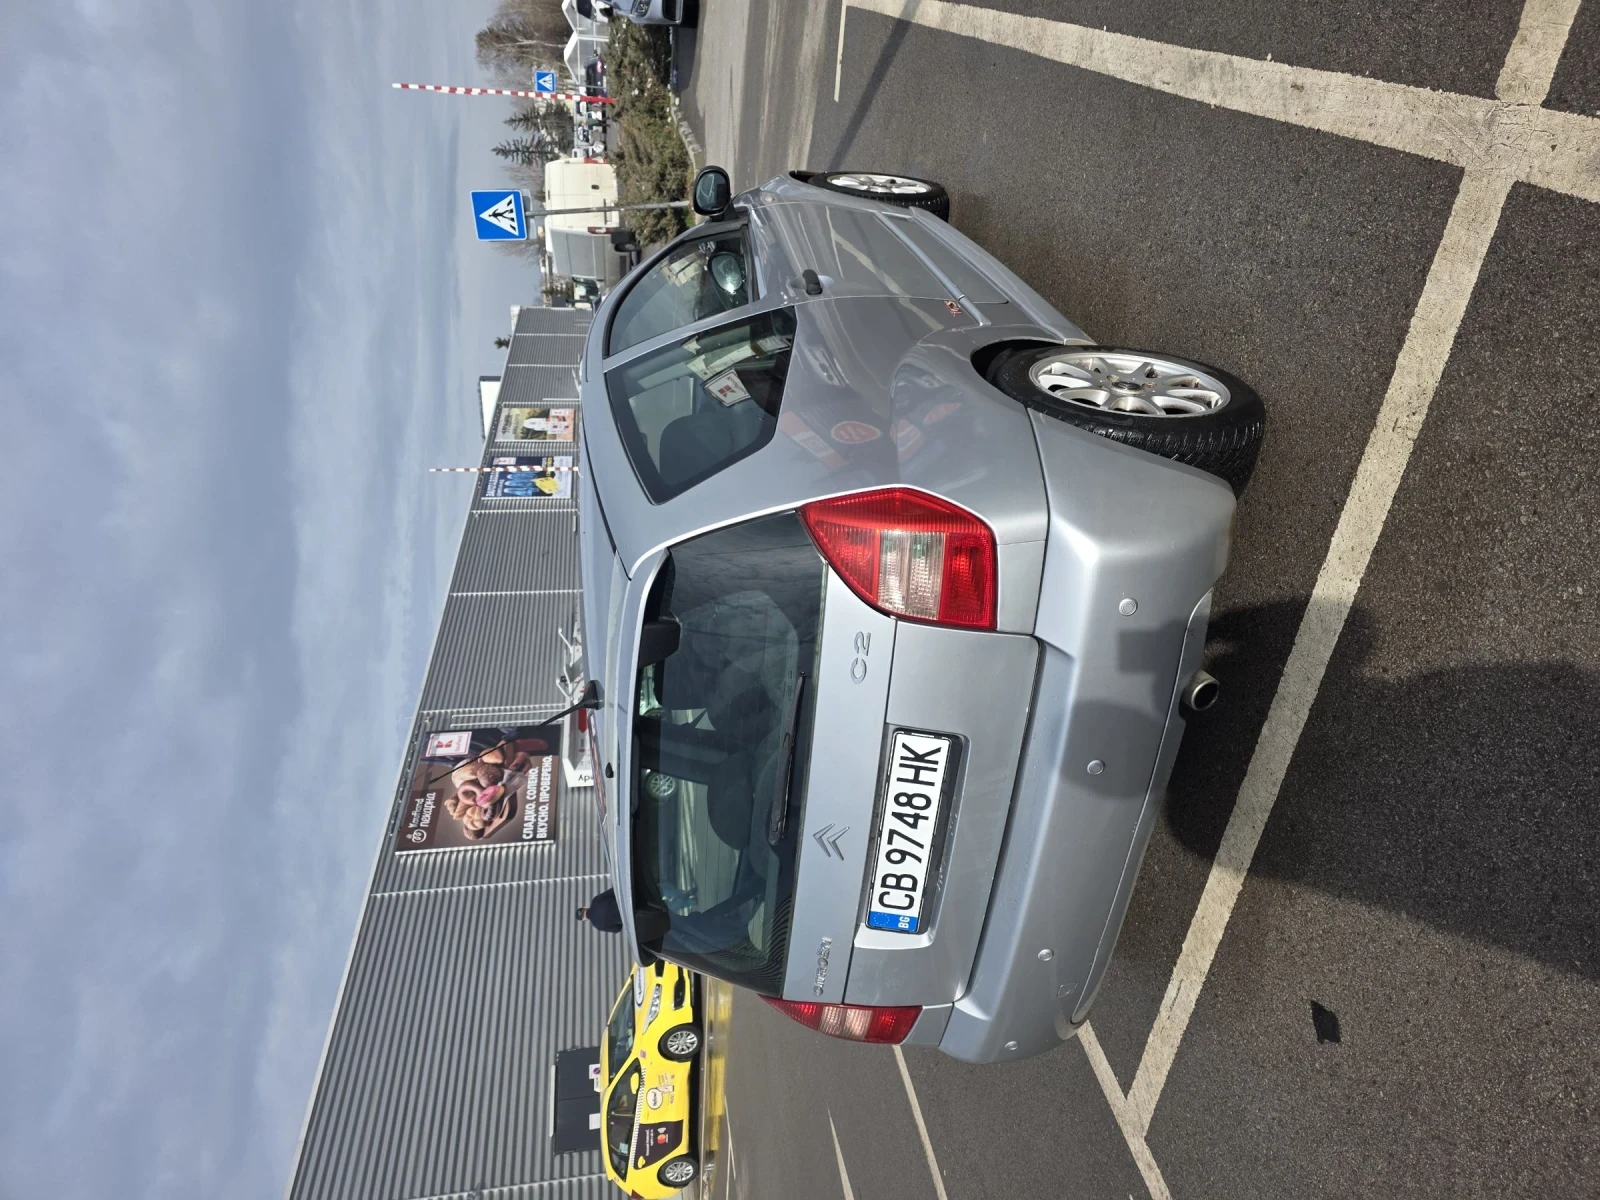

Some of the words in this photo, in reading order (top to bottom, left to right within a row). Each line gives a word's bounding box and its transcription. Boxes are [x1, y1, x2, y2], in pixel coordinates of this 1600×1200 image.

[850, 630, 872, 685] C2
[526, 766, 539, 800] СОЛЕНО.
[539, 755, 553, 802] ПРОВЕРЕНО.
[896, 742, 942, 787] HK
[408, 798, 424, 829] Kaufland
[420, 792, 436, 828] пекарна
[522, 801, 536, 840] СЛАДКО.
[536, 802, 549, 839] ВКУСНО.
[884, 791, 932, 864] 9748
[878, 873, 919, 911] CB
[897, 915, 911, 929] BG
[812, 936, 833, 997] CITROËN
